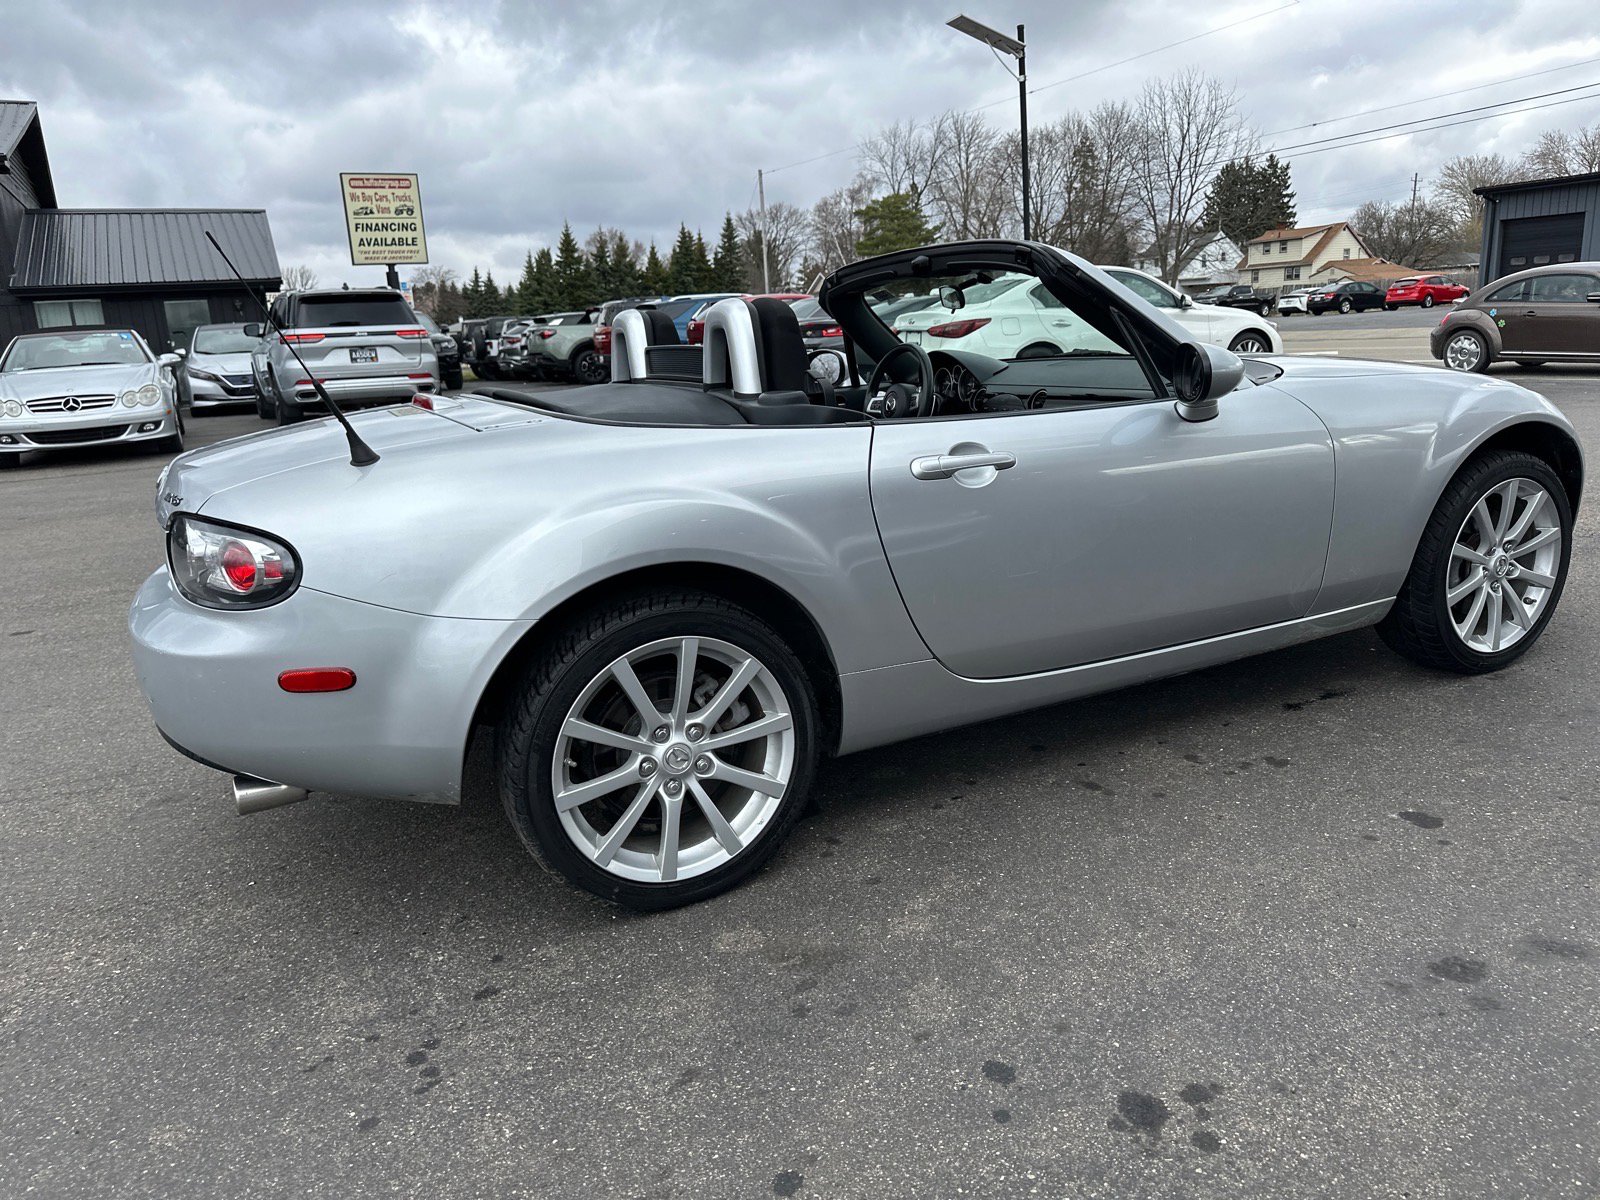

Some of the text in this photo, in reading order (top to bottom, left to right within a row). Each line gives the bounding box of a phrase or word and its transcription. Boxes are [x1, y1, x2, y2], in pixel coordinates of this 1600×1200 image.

[350, 192, 414, 204] We Buy Cars, Trucks,
[376, 204, 391, 214] Vans
[355, 223, 417, 232] FINANCING
[358, 238, 418, 247] AVAILABLE
